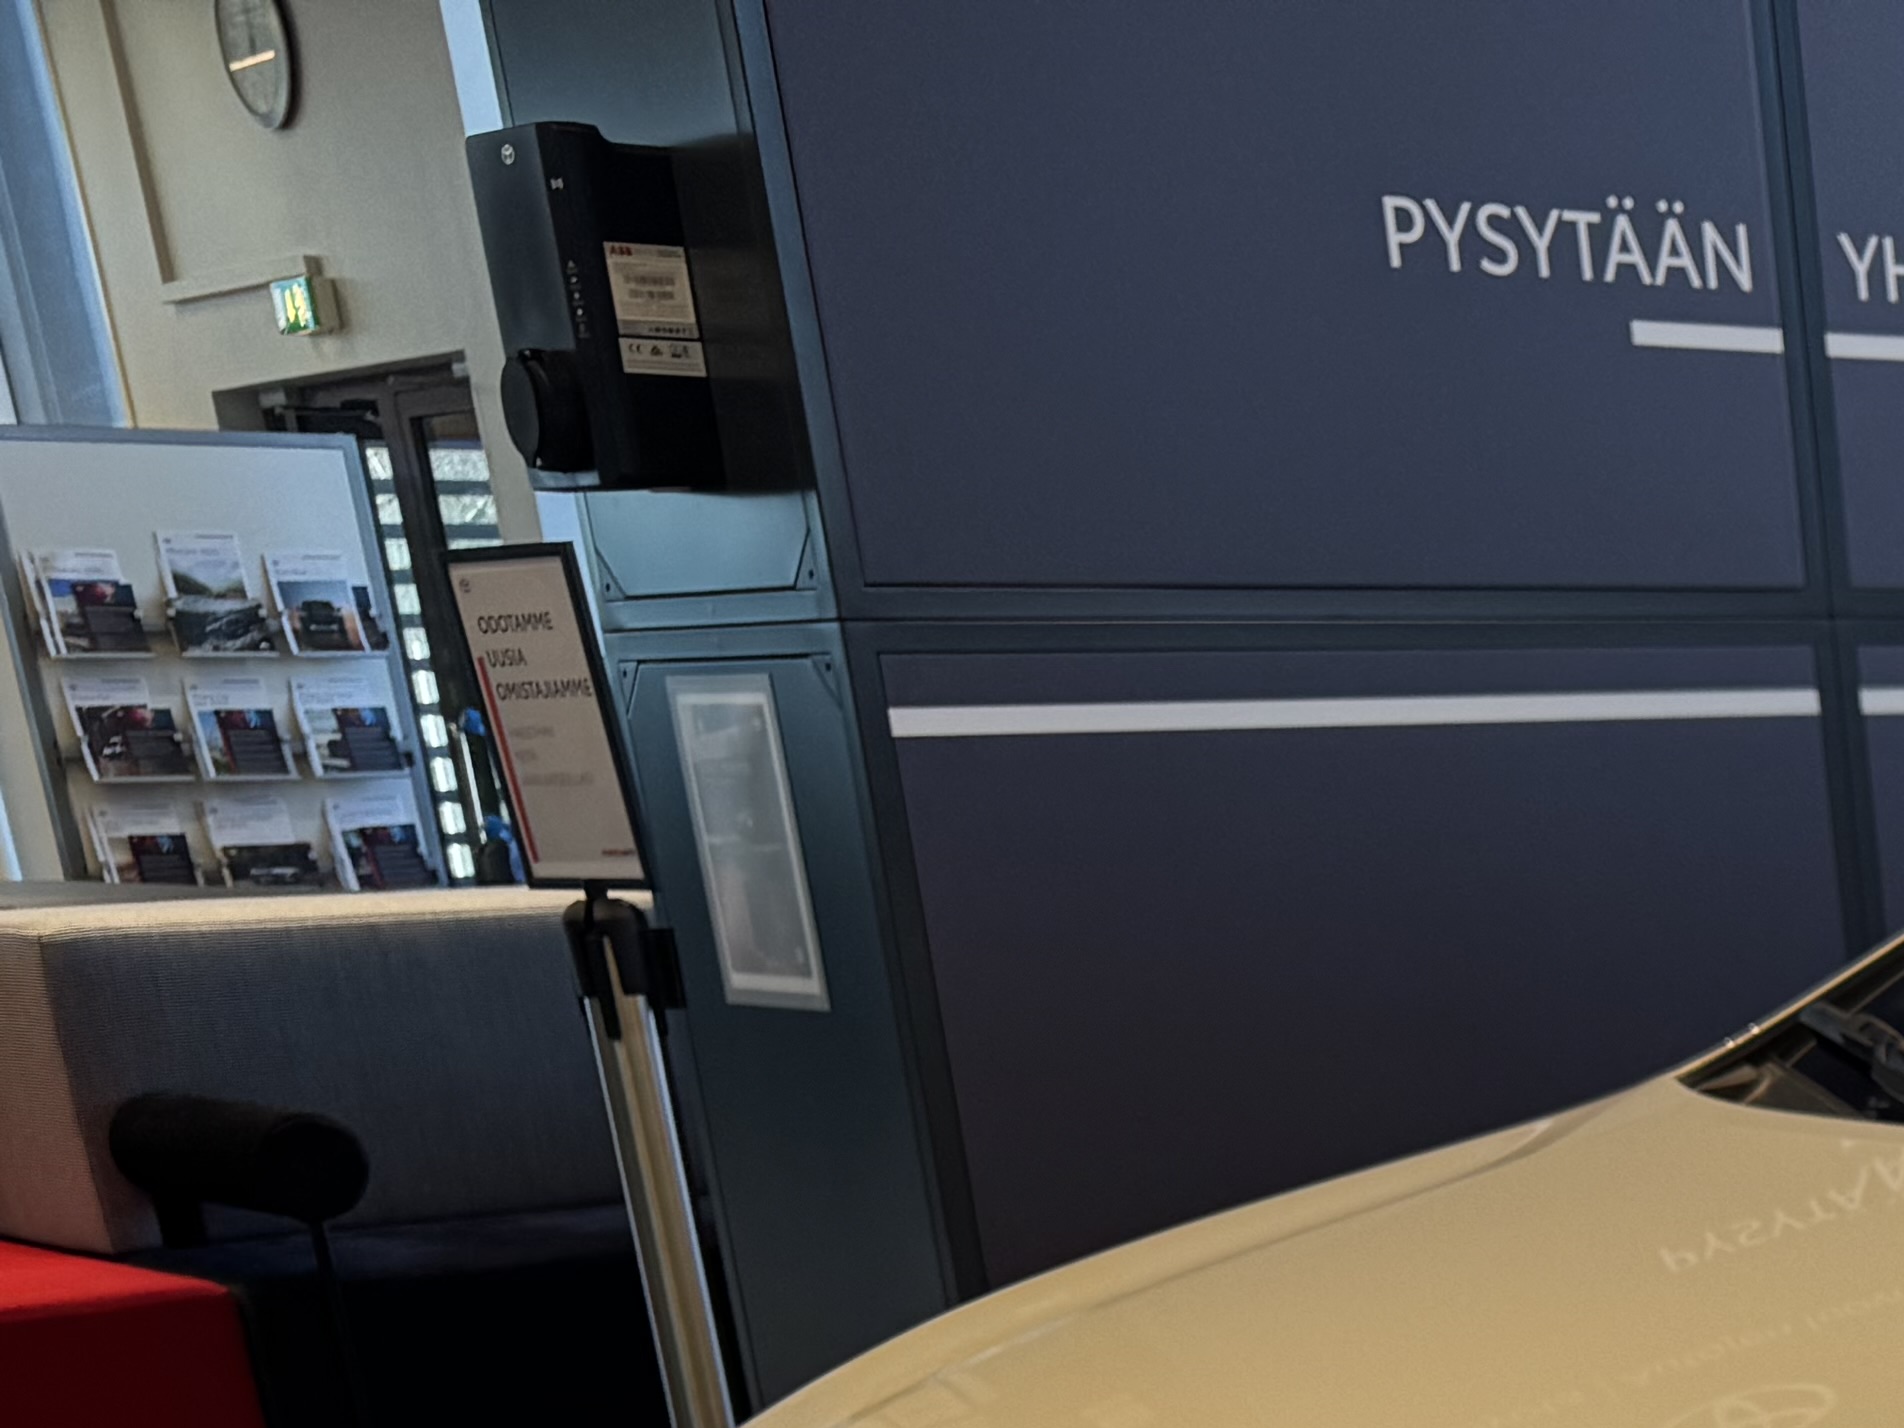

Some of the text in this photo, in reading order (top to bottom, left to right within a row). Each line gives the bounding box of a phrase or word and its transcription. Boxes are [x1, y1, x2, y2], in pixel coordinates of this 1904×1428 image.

[1381, 194, 1753, 294] PYSYTÄÄN
[477, 611, 553, 635] ODOTAMME
[486, 648, 528, 668] UUSIA
[495, 677, 593, 701] OMISTAJIAMME
